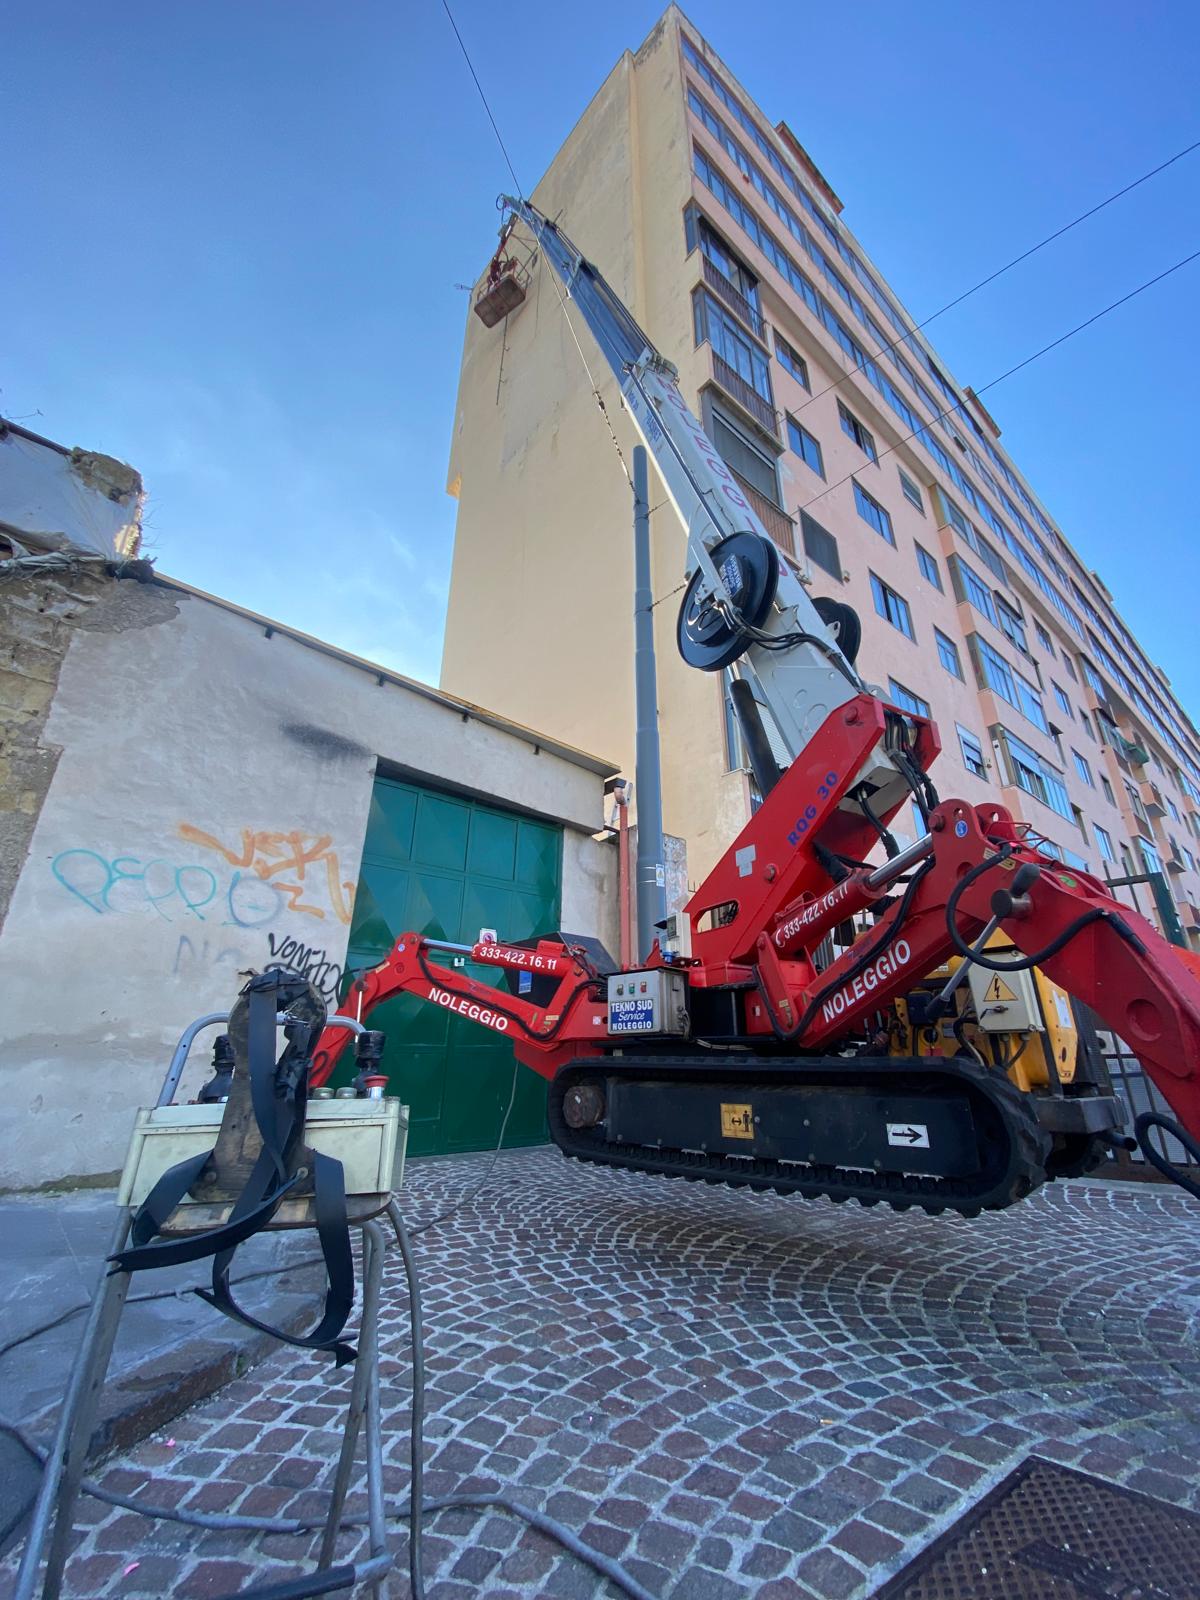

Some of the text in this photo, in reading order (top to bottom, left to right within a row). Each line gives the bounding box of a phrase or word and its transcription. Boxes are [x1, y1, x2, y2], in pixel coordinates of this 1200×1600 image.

[786, 771, 839, 848] ROG 30
[783, 881, 849, 940] 333-422.16.11
[480, 946, 557, 970] 333-422.16.11
[822, 939, 911, 1024] NOLEGGIO
[428, 988, 508, 1031] NOLEGGIO
[611, 1000, 653, 1013] TEKNO SUD
[618, 1010, 645, 1021] Service
[612, 1021, 652, 1031] NOLEGGIO
